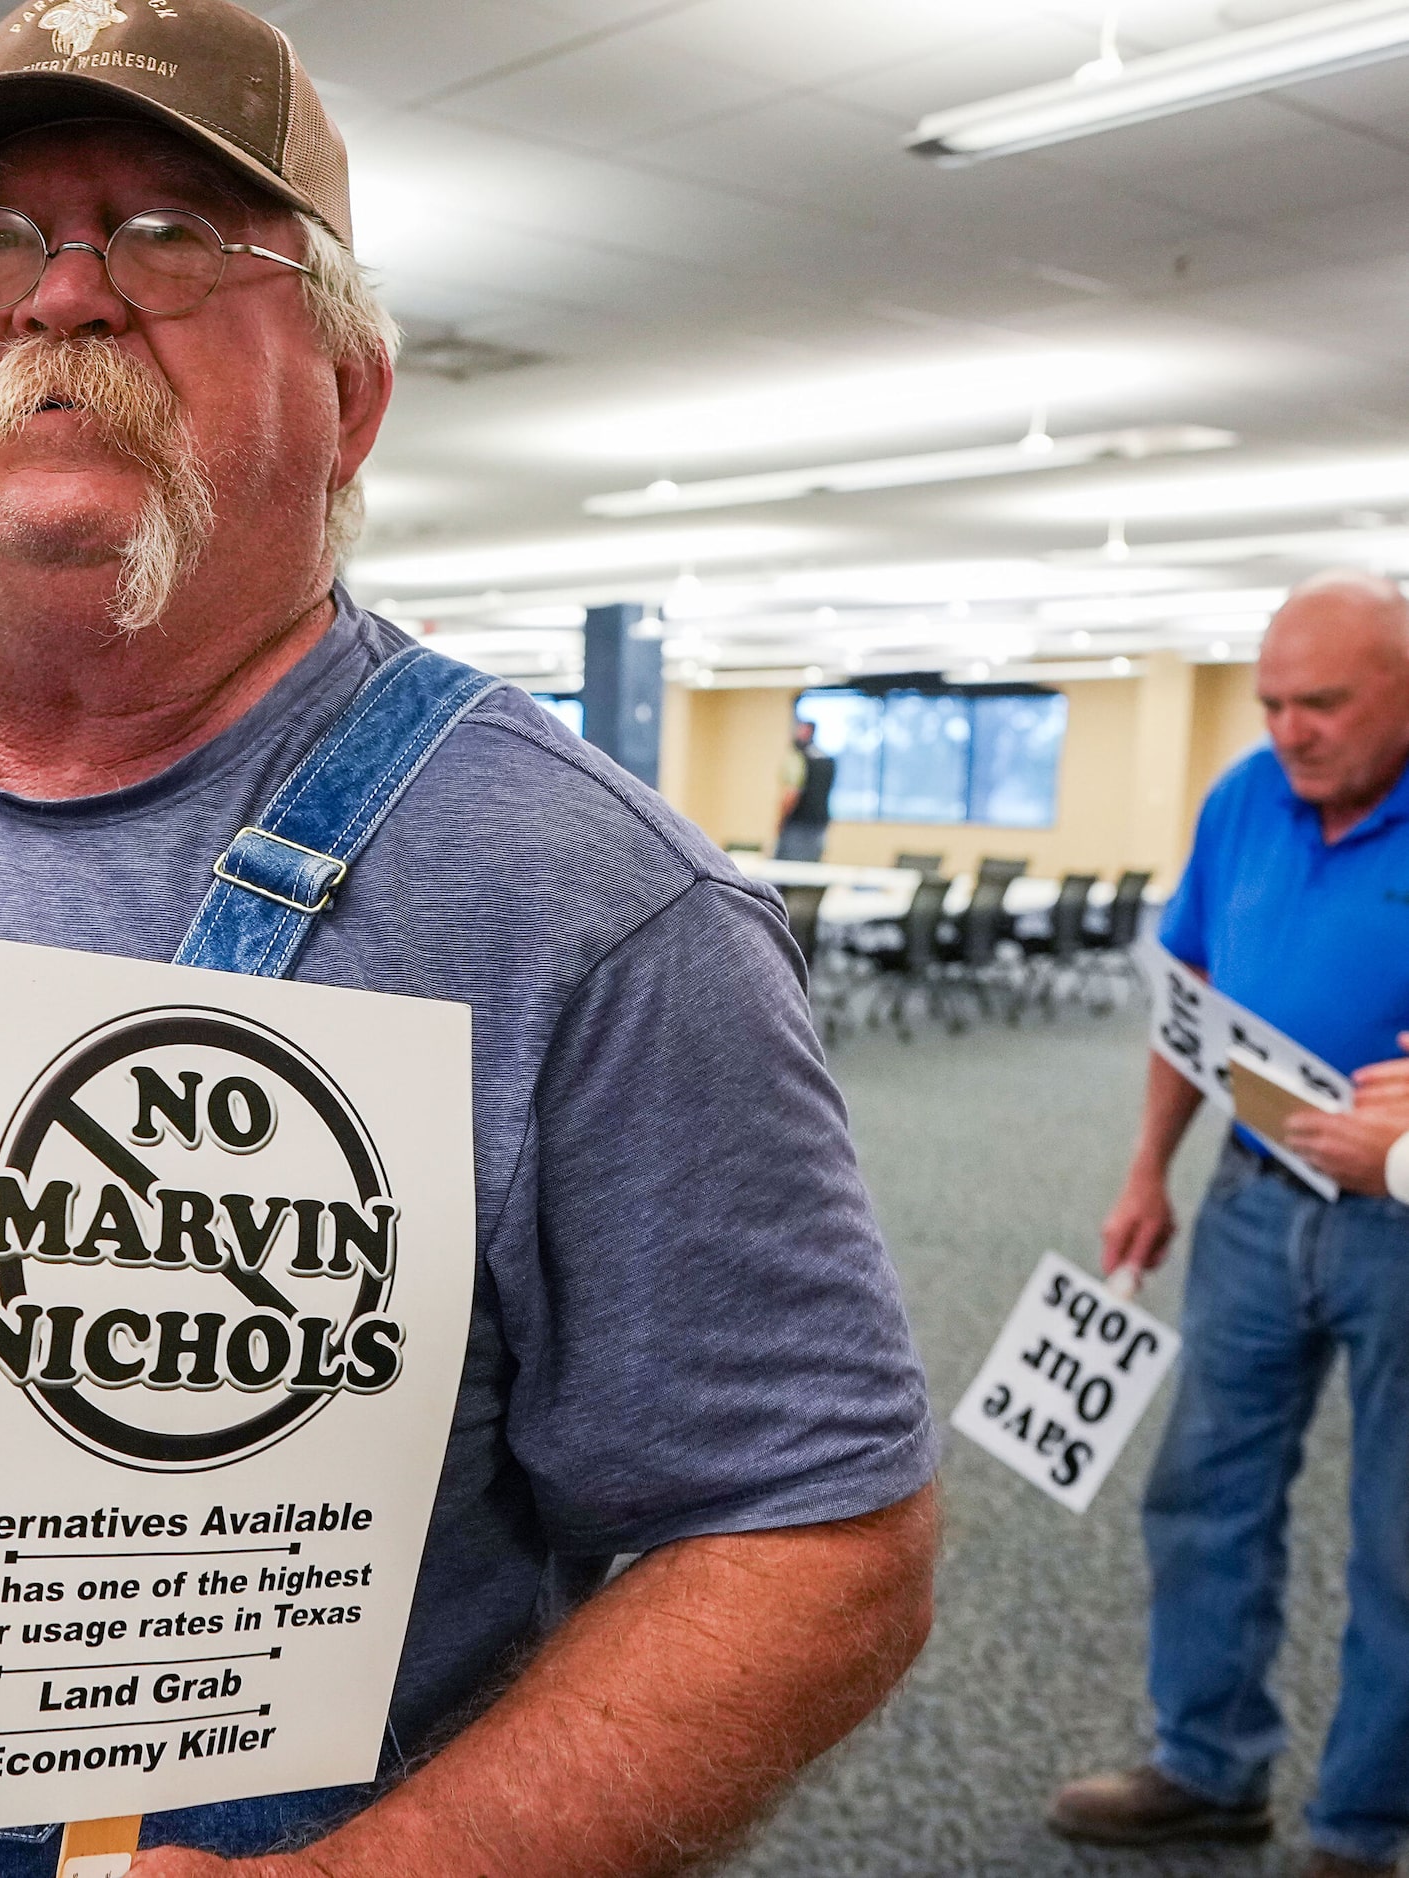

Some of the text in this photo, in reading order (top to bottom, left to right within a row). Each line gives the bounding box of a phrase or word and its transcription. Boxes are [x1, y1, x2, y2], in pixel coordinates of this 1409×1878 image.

[77, 50, 179, 79] WEDNESDAY
[128, 1065, 275, 1151] NO
[1044, 1272, 1160, 1374] Jobs
[1020, 1337, 1116, 1425] Our
[981, 1383, 1095, 1488] Save
[199, 1502, 373, 1536] Available
[1, 1576, 65, 1603] has
[77, 1579, 140, 1601] one
[152, 1571, 188, 1598] of
[197, 1569, 248, 1596] the
[258, 1562, 373, 1597] highest
[21, 1618, 127, 1648] usage
[138, 1611, 224, 1638] rates
[234, 1606, 262, 1632] in
[273, 1603, 362, 1629] Texas
[39, 1668, 242, 1712] Land Grab
[178, 1724, 277, 1761] Killer
